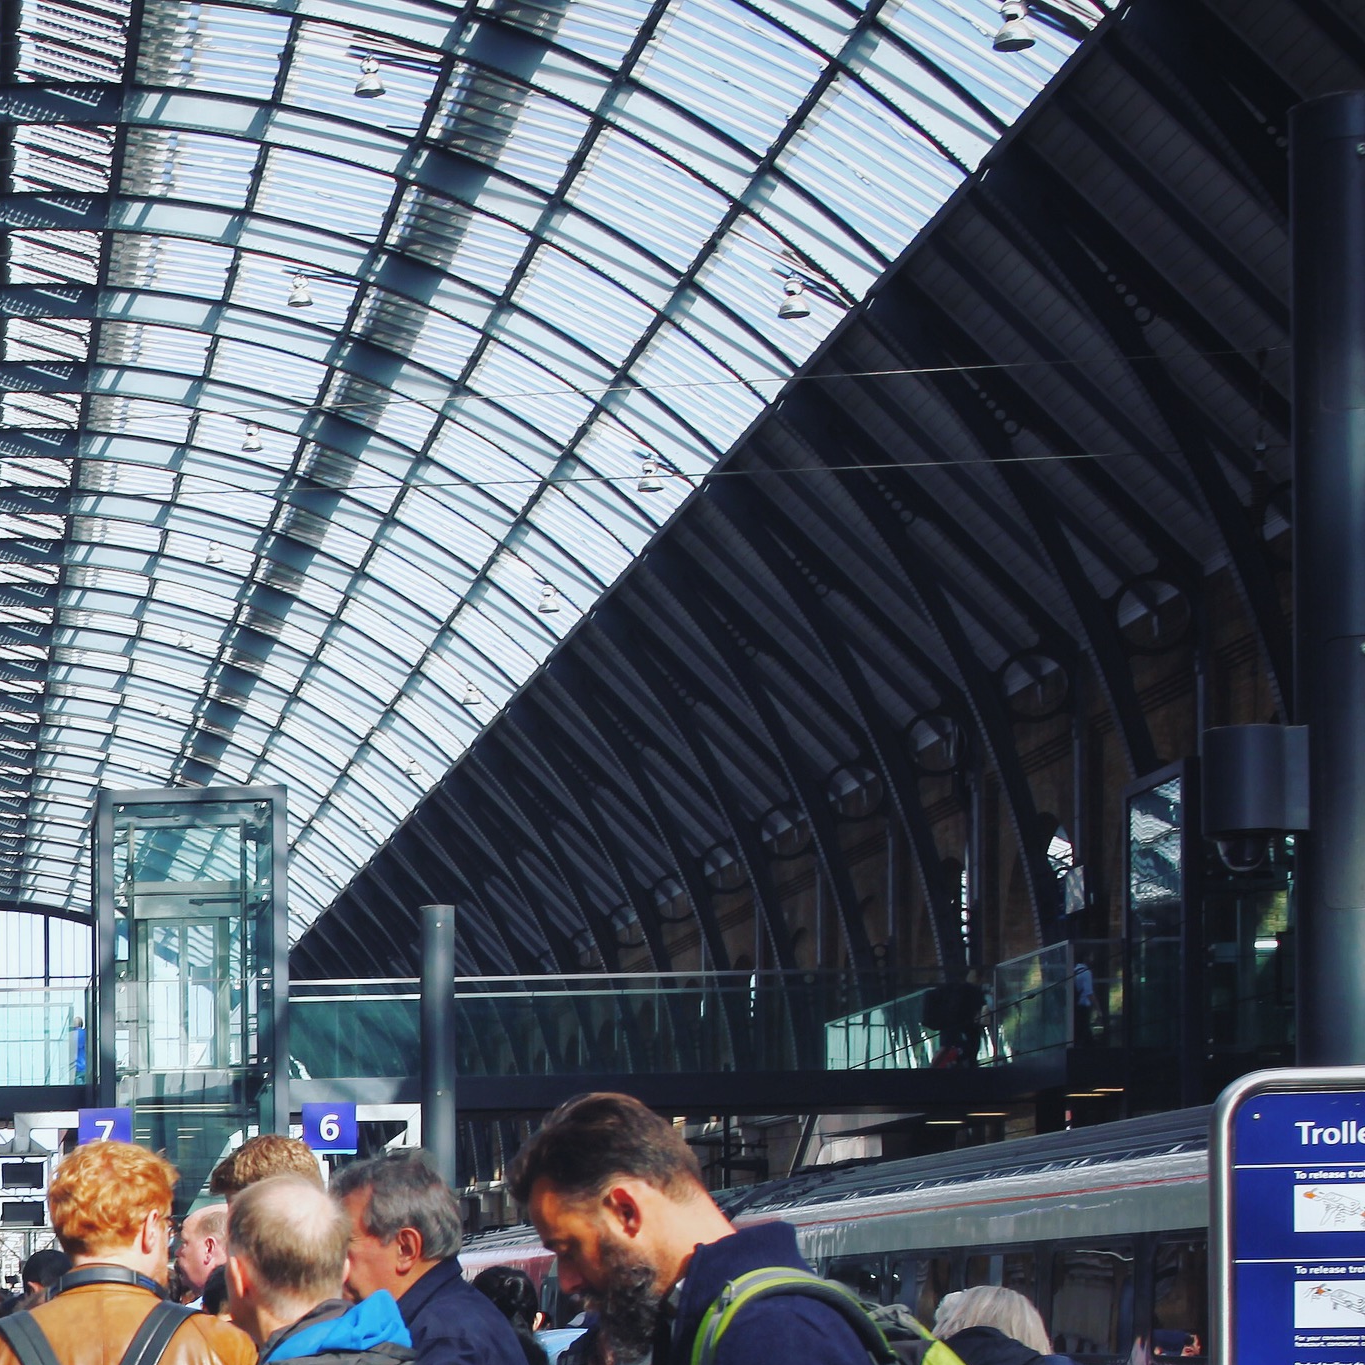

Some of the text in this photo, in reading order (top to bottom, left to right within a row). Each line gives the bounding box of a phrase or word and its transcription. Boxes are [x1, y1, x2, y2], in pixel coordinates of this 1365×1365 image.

[95, 1120, 116, 1142] 7
[319, 1114, 340, 1141] 6
[1294, 1170, 1307, 1179] To
[1308, 1170, 1346, 1179] release
[1294, 1265, 1307, 1274] To
[1309, 1265, 1346, 1274] release
